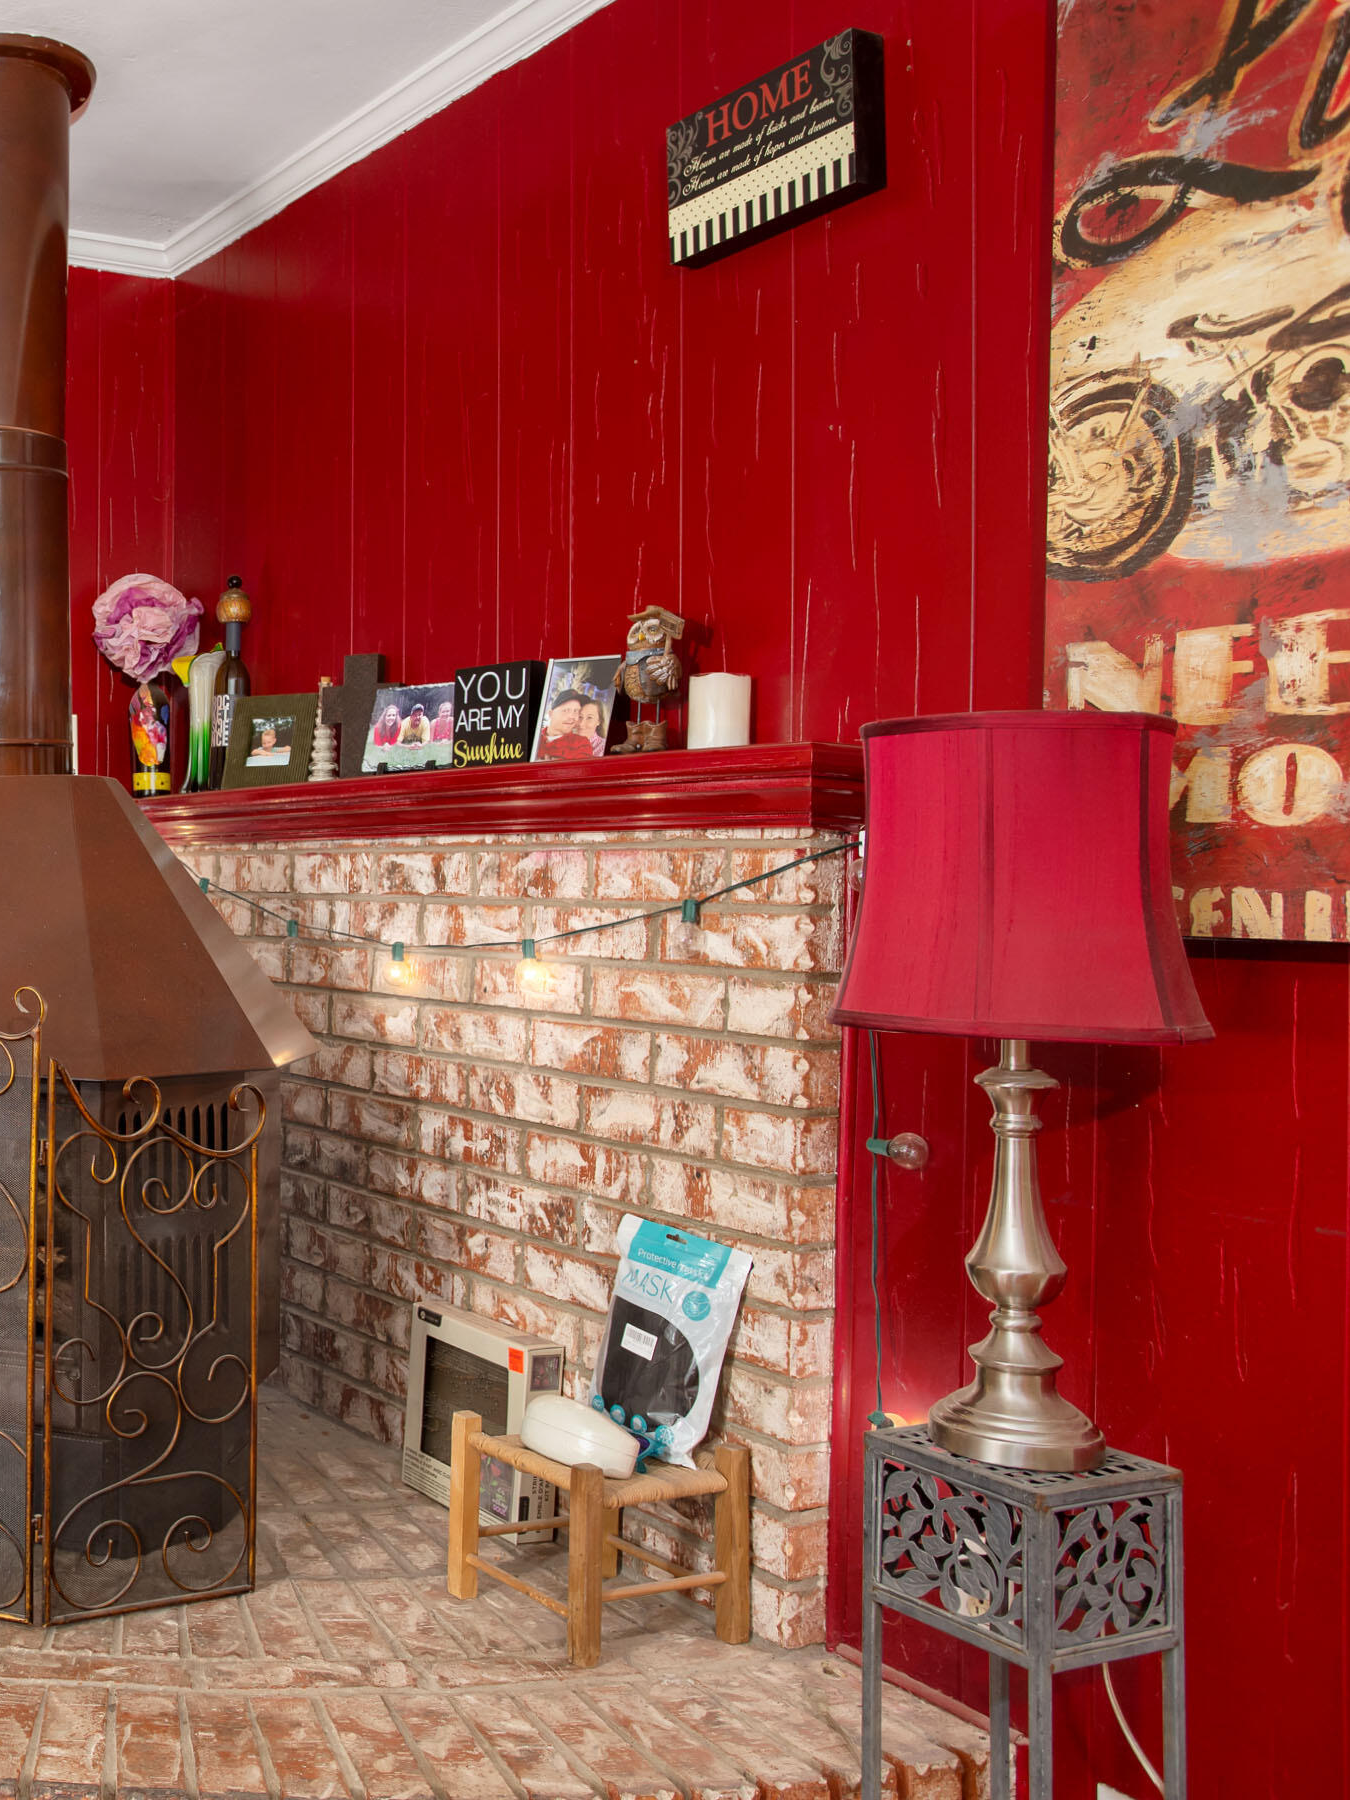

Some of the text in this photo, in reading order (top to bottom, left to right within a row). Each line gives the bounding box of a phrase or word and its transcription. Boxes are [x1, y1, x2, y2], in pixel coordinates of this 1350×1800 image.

[705, 59, 813, 147] HOME
[719, 149, 730, 160] are
[733, 133, 753, 152] made
[755, 124, 767, 145] of
[766, 116, 787, 136] bricks
[790, 104, 808, 124] and
[682, 171, 715, 196] Homes
[717, 169, 729, 180] are
[731, 154, 751, 173] made
[753, 145, 765, 166] of
[764, 141, 785, 158] hopes
[788, 126, 806, 145] and
[457, 667, 526, 704] YOU
[455, 703, 525, 733] ARE MY
[453, 732, 524, 768] Sunshine
[637, 1247, 677, 1268] Protective
[621, 1268, 673, 1304] MASK
